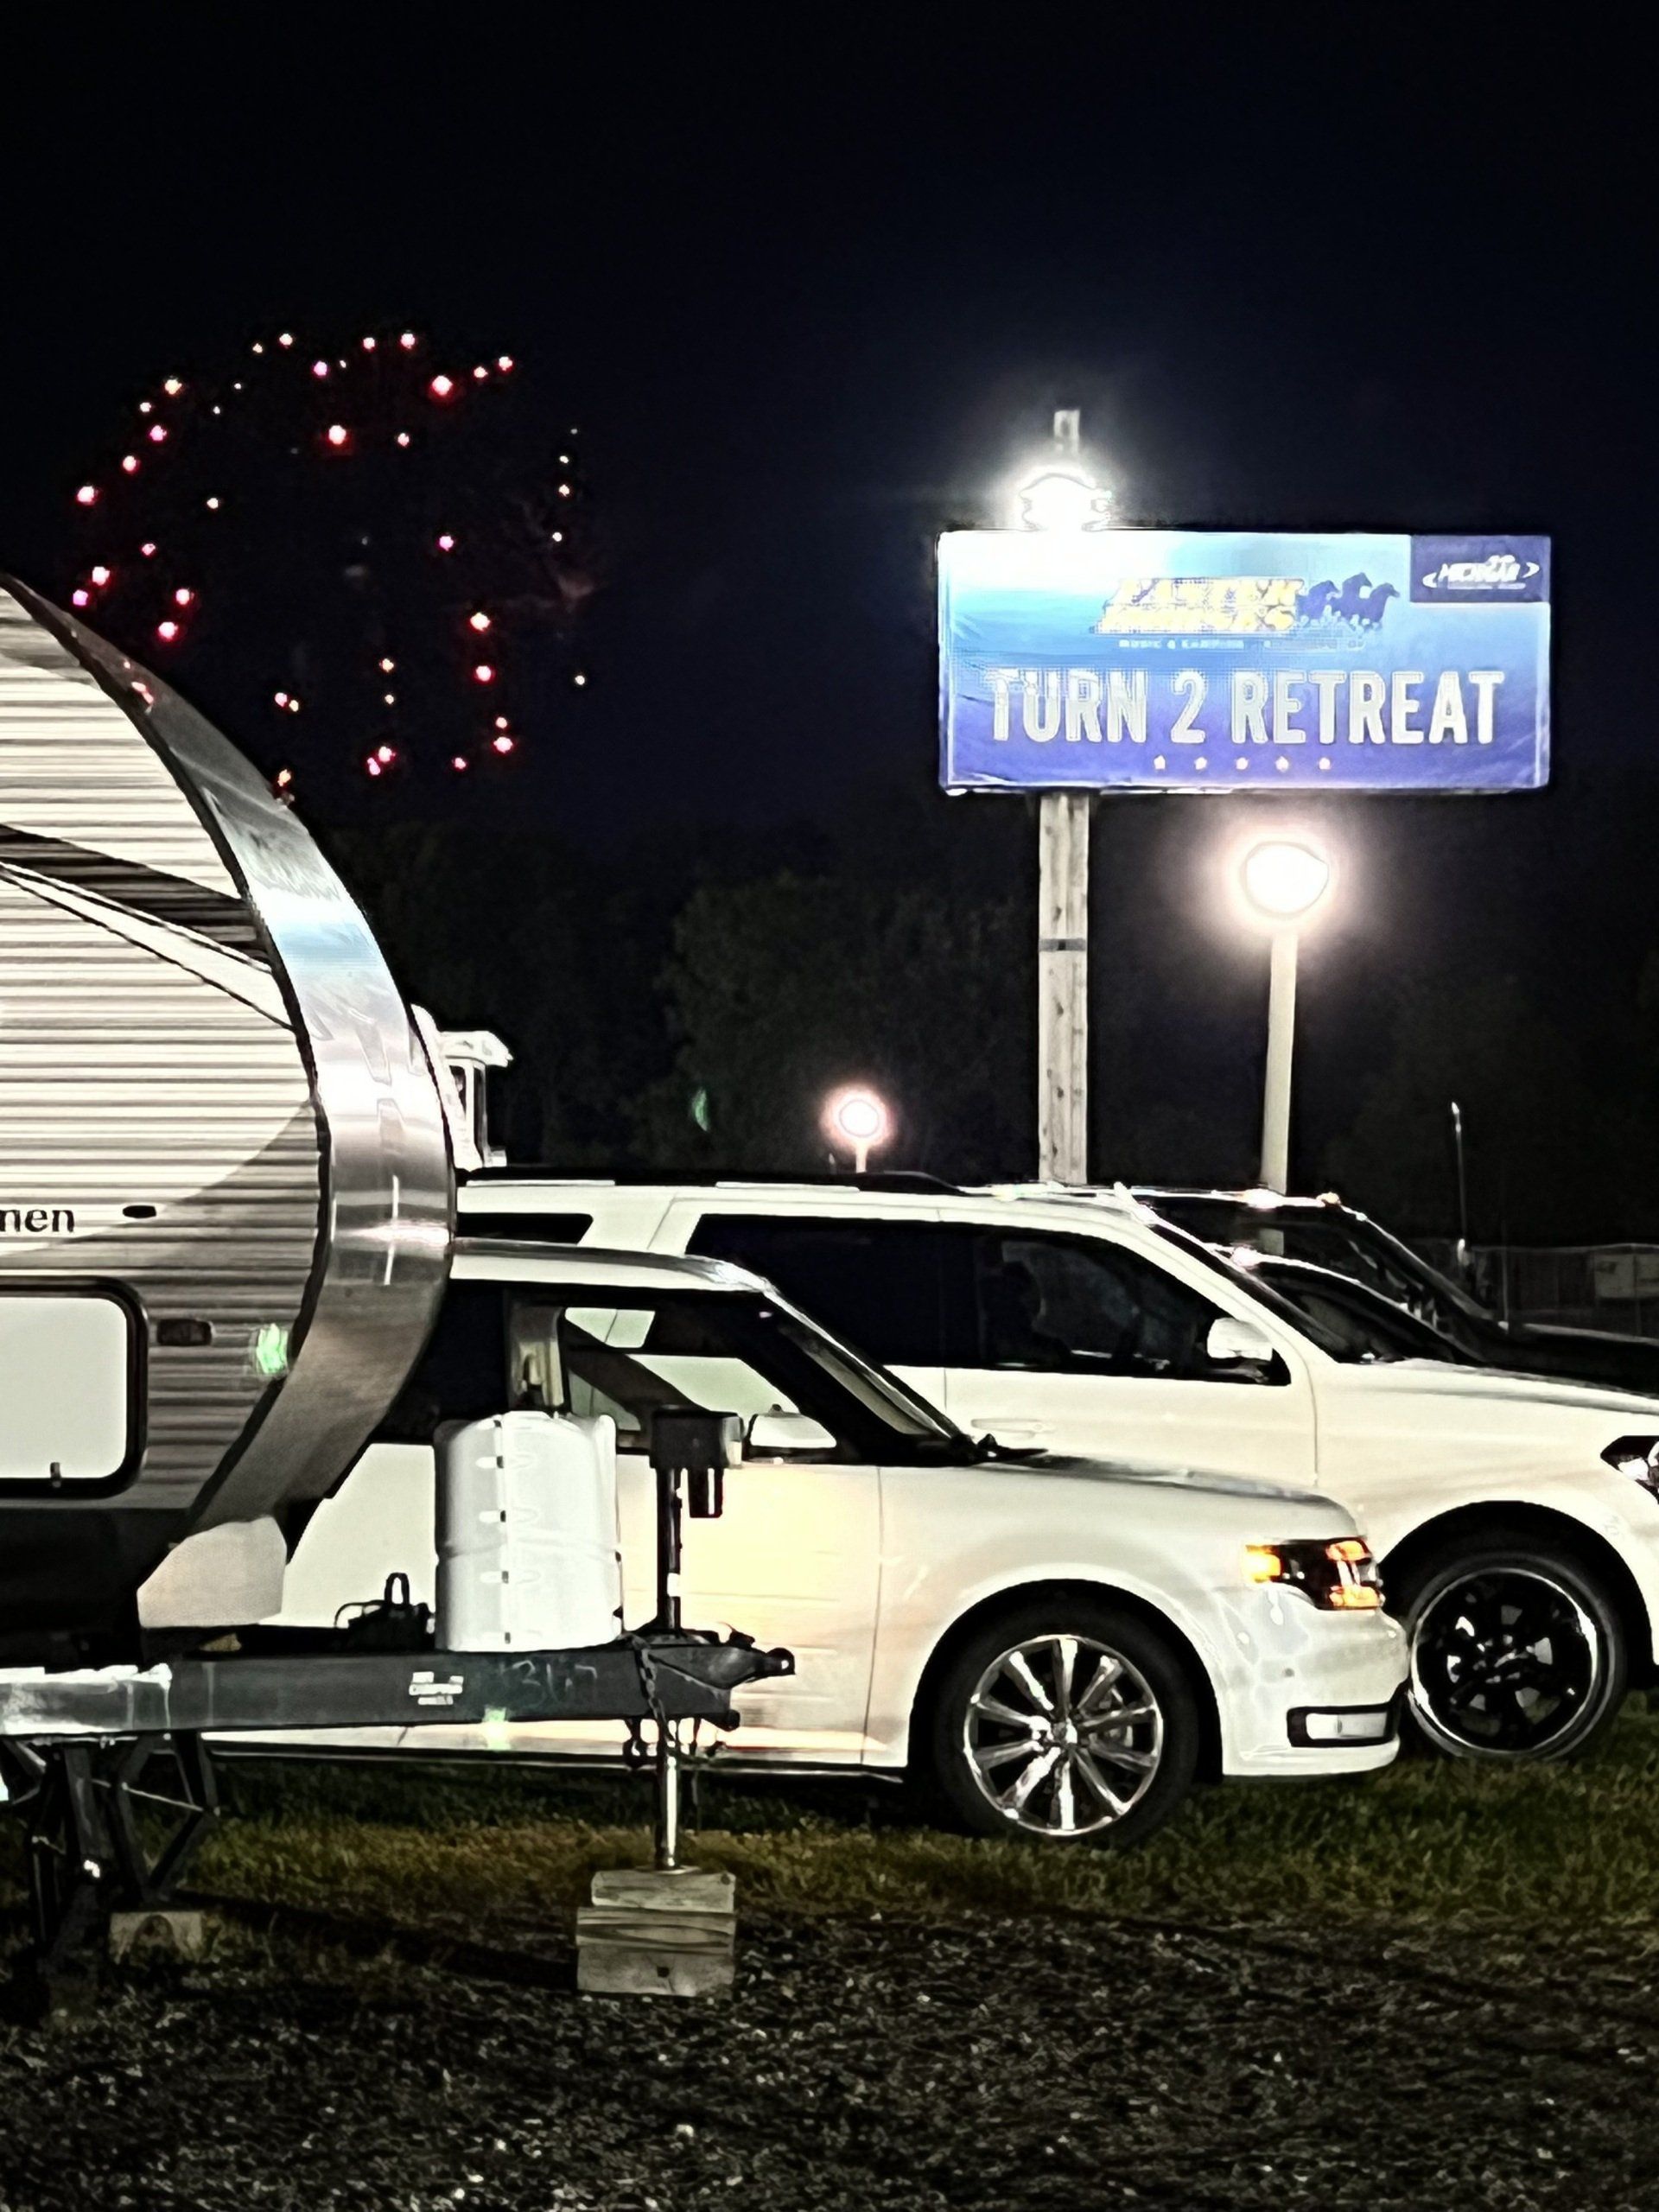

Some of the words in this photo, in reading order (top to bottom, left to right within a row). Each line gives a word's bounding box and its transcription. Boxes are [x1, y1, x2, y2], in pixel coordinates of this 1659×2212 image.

[989, 669, 1147, 743] TURN
[1170, 669, 1207, 743] 2
[1230, 670, 1505, 744] RETREAT
